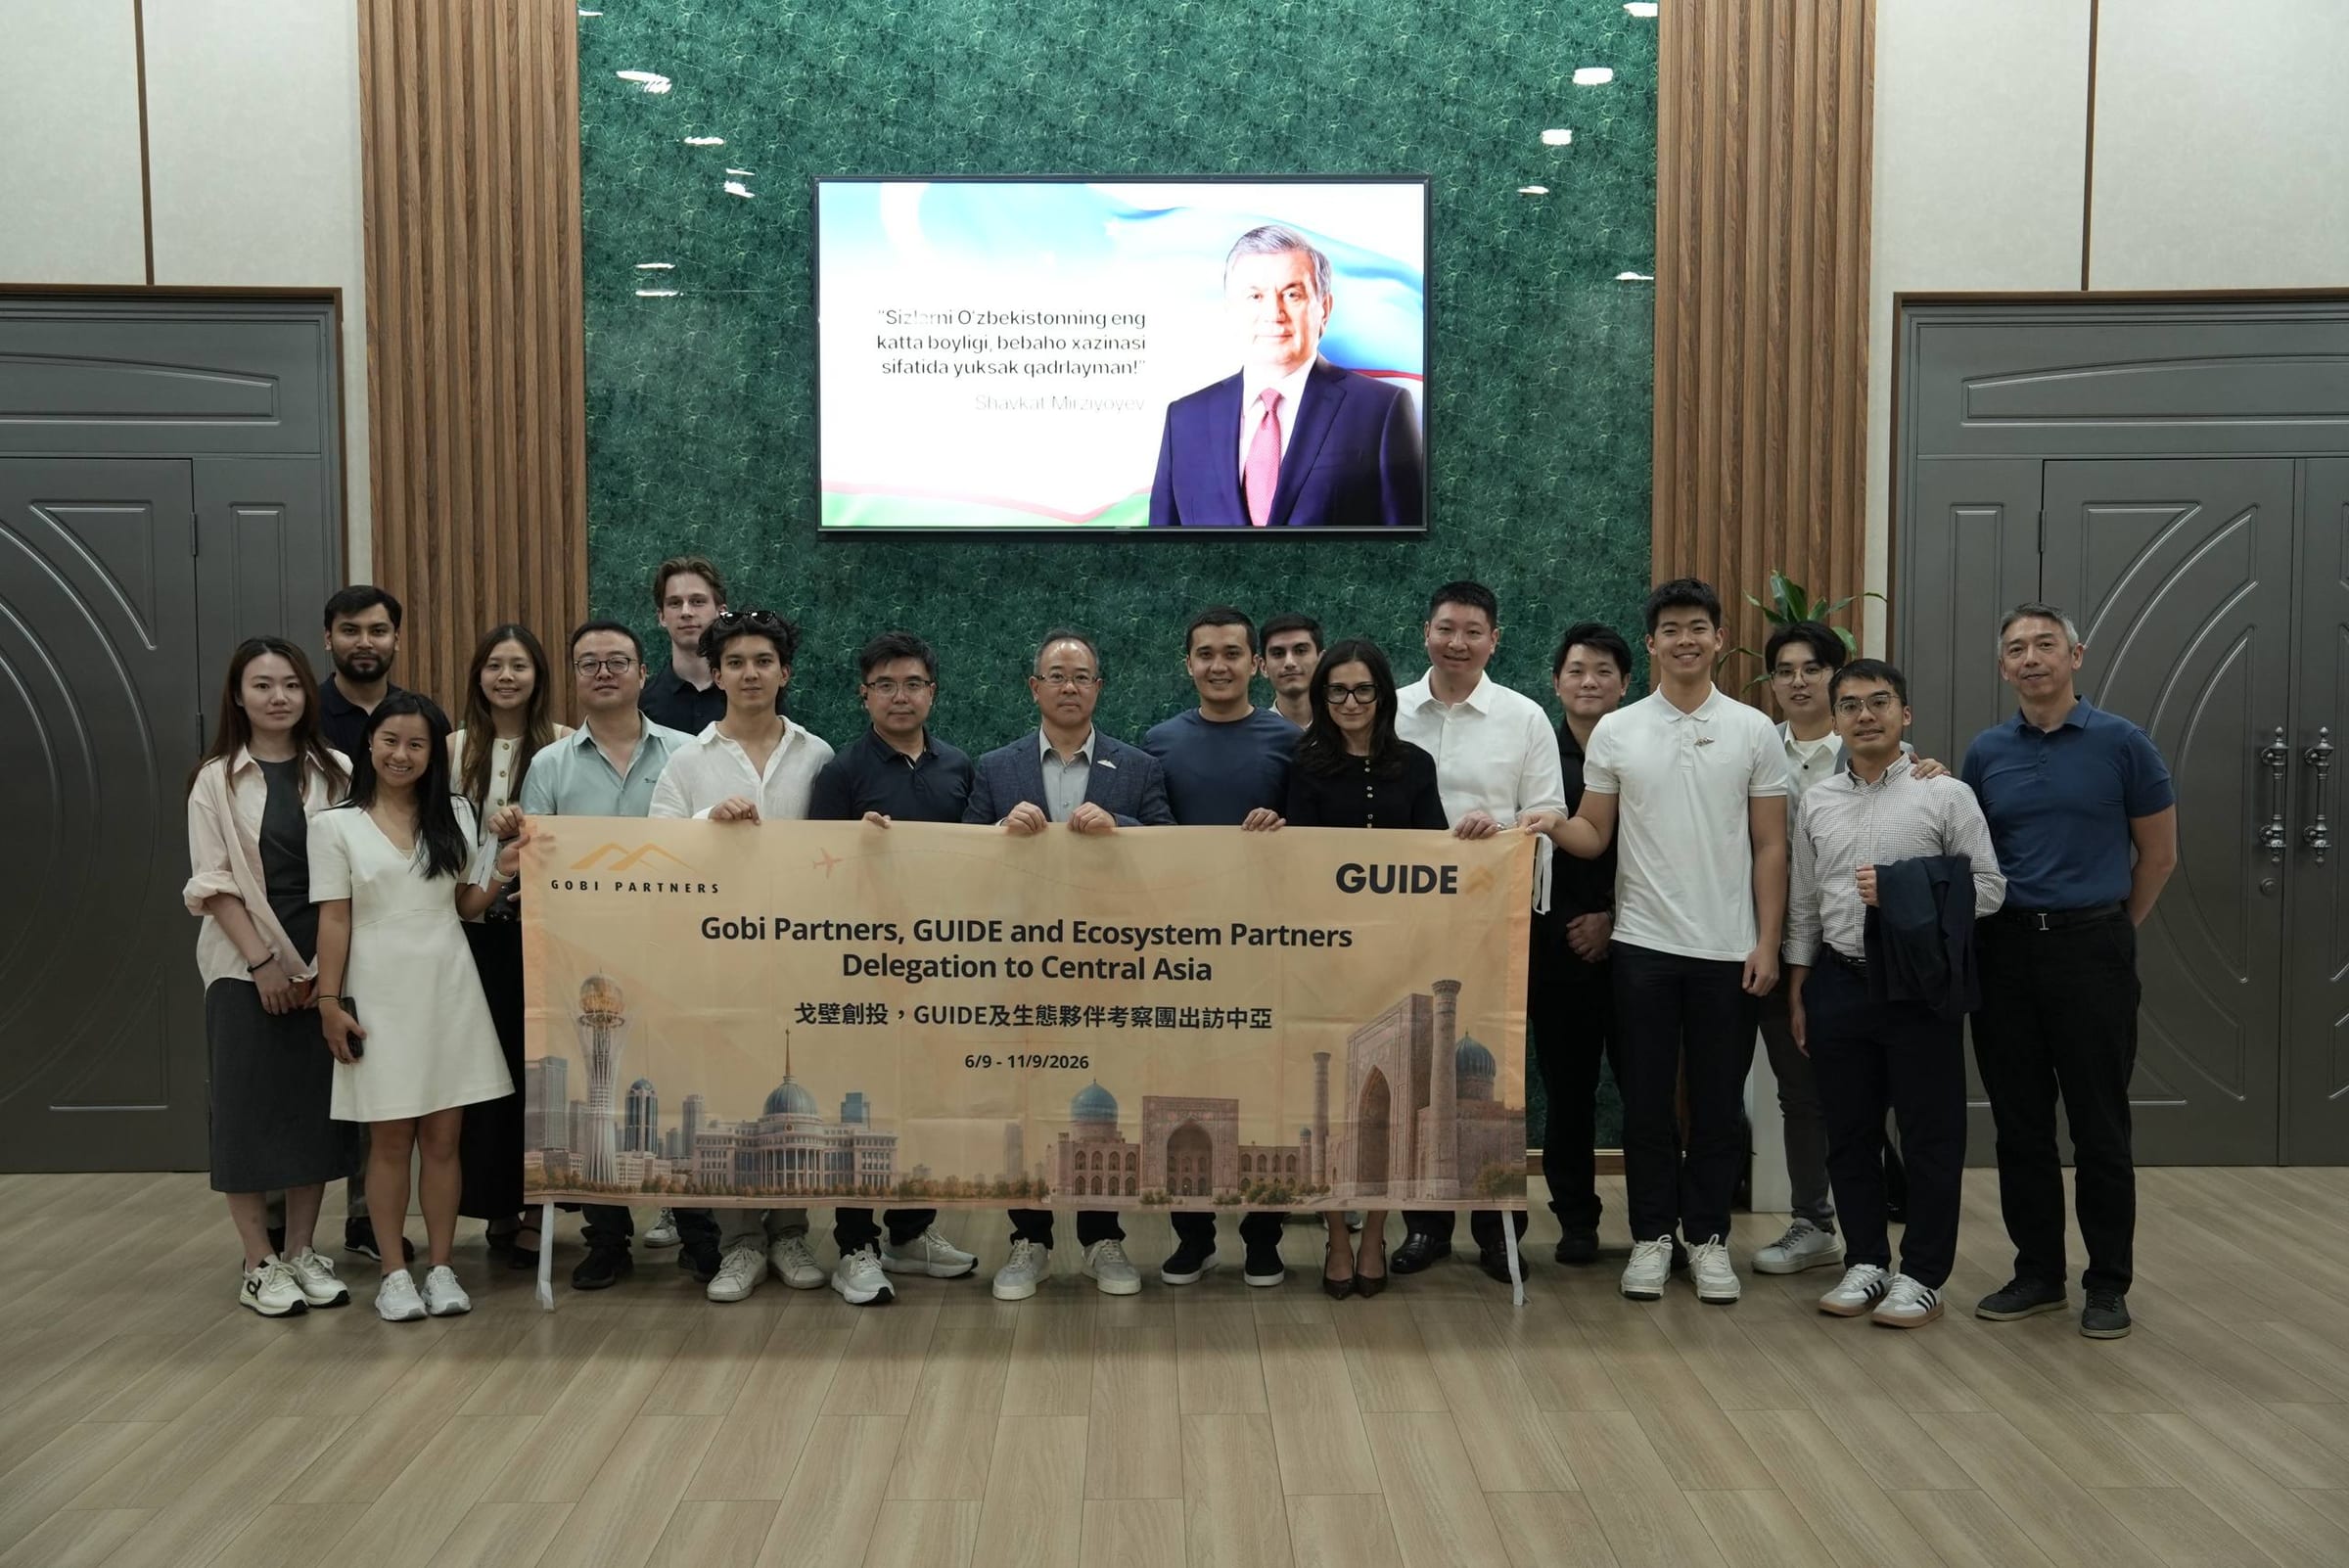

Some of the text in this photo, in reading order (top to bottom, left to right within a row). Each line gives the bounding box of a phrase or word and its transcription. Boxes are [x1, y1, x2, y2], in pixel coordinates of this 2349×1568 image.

[1112, 314, 1145, 330] eng
[877, 334, 1146, 354] katta boyligi, bebaho xazinasi
[881, 358, 948, 375] sifatida
[953, 359, 1018, 379] yuksak
[975, 394, 1045, 411] Shavkat
[551, 879, 719, 894] GOBI PARTNERS
[1336, 863, 1457, 895] GUIDE
[701, 916, 1353, 951] Gobi Partners, GUIDE and Ecosystem Partners
[843, 953, 1212, 985] Delegation to Central Asia
[964, 1054, 992, 1069] 6/9
[1007, 1054, 1089, 1070] 11/9/2026
